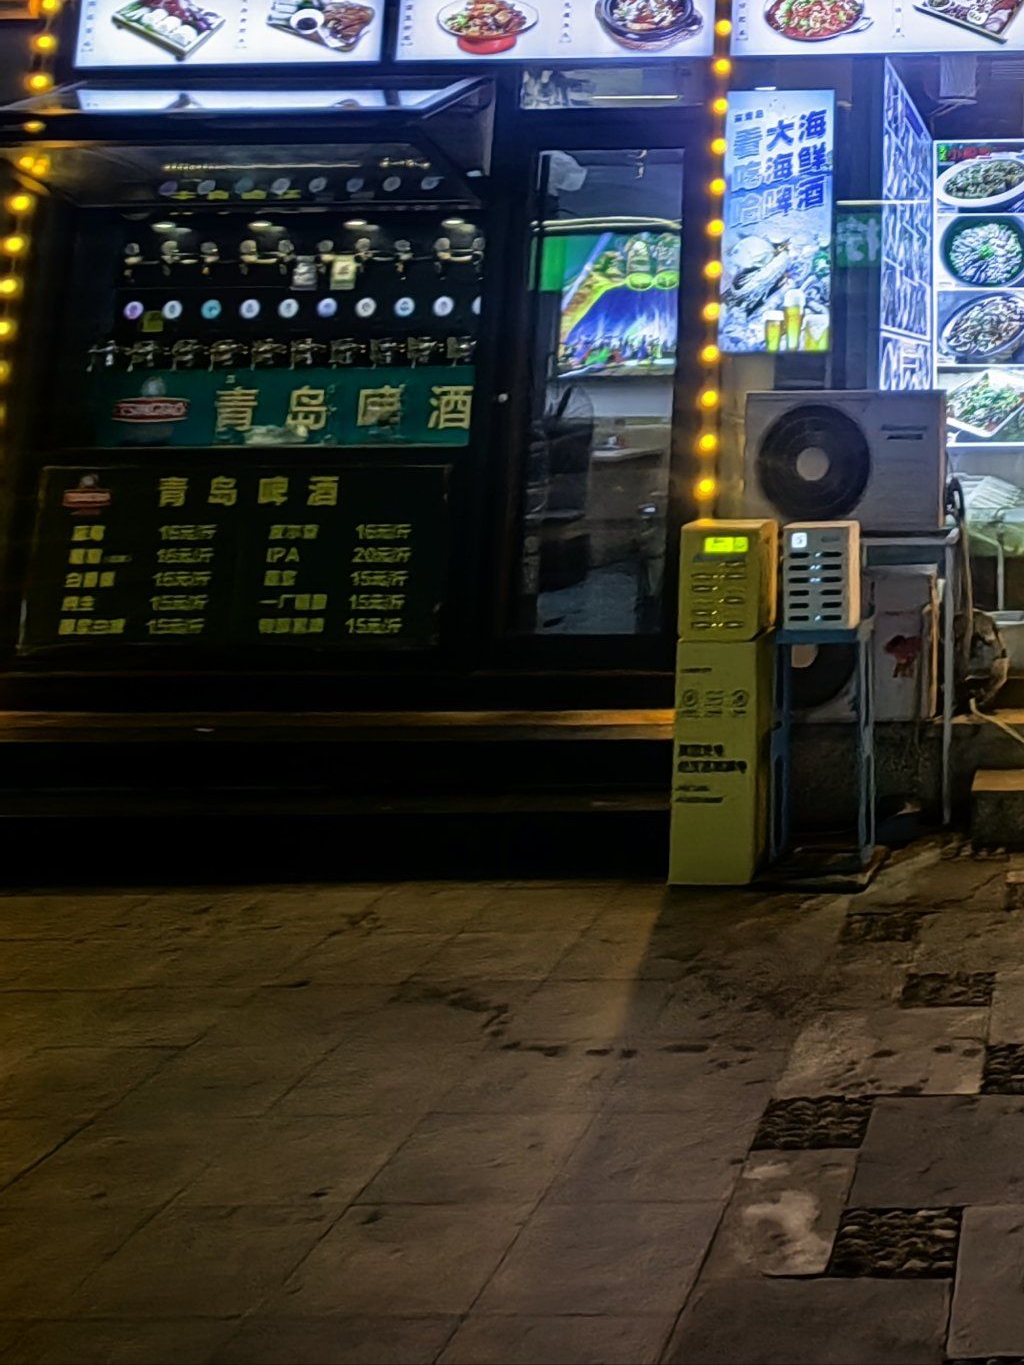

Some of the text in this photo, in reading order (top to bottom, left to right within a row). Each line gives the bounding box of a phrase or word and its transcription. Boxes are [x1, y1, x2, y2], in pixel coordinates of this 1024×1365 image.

[733, 109, 828, 160] 看大海
[731, 142, 828, 193] 吃海鲜
[730, 175, 826, 228] 哈啤酒
[214, 385, 474, 433] 青岛啤酒
[158, 476, 339, 507] 青岛啤酒
[266, 547, 300, 563] IPA
